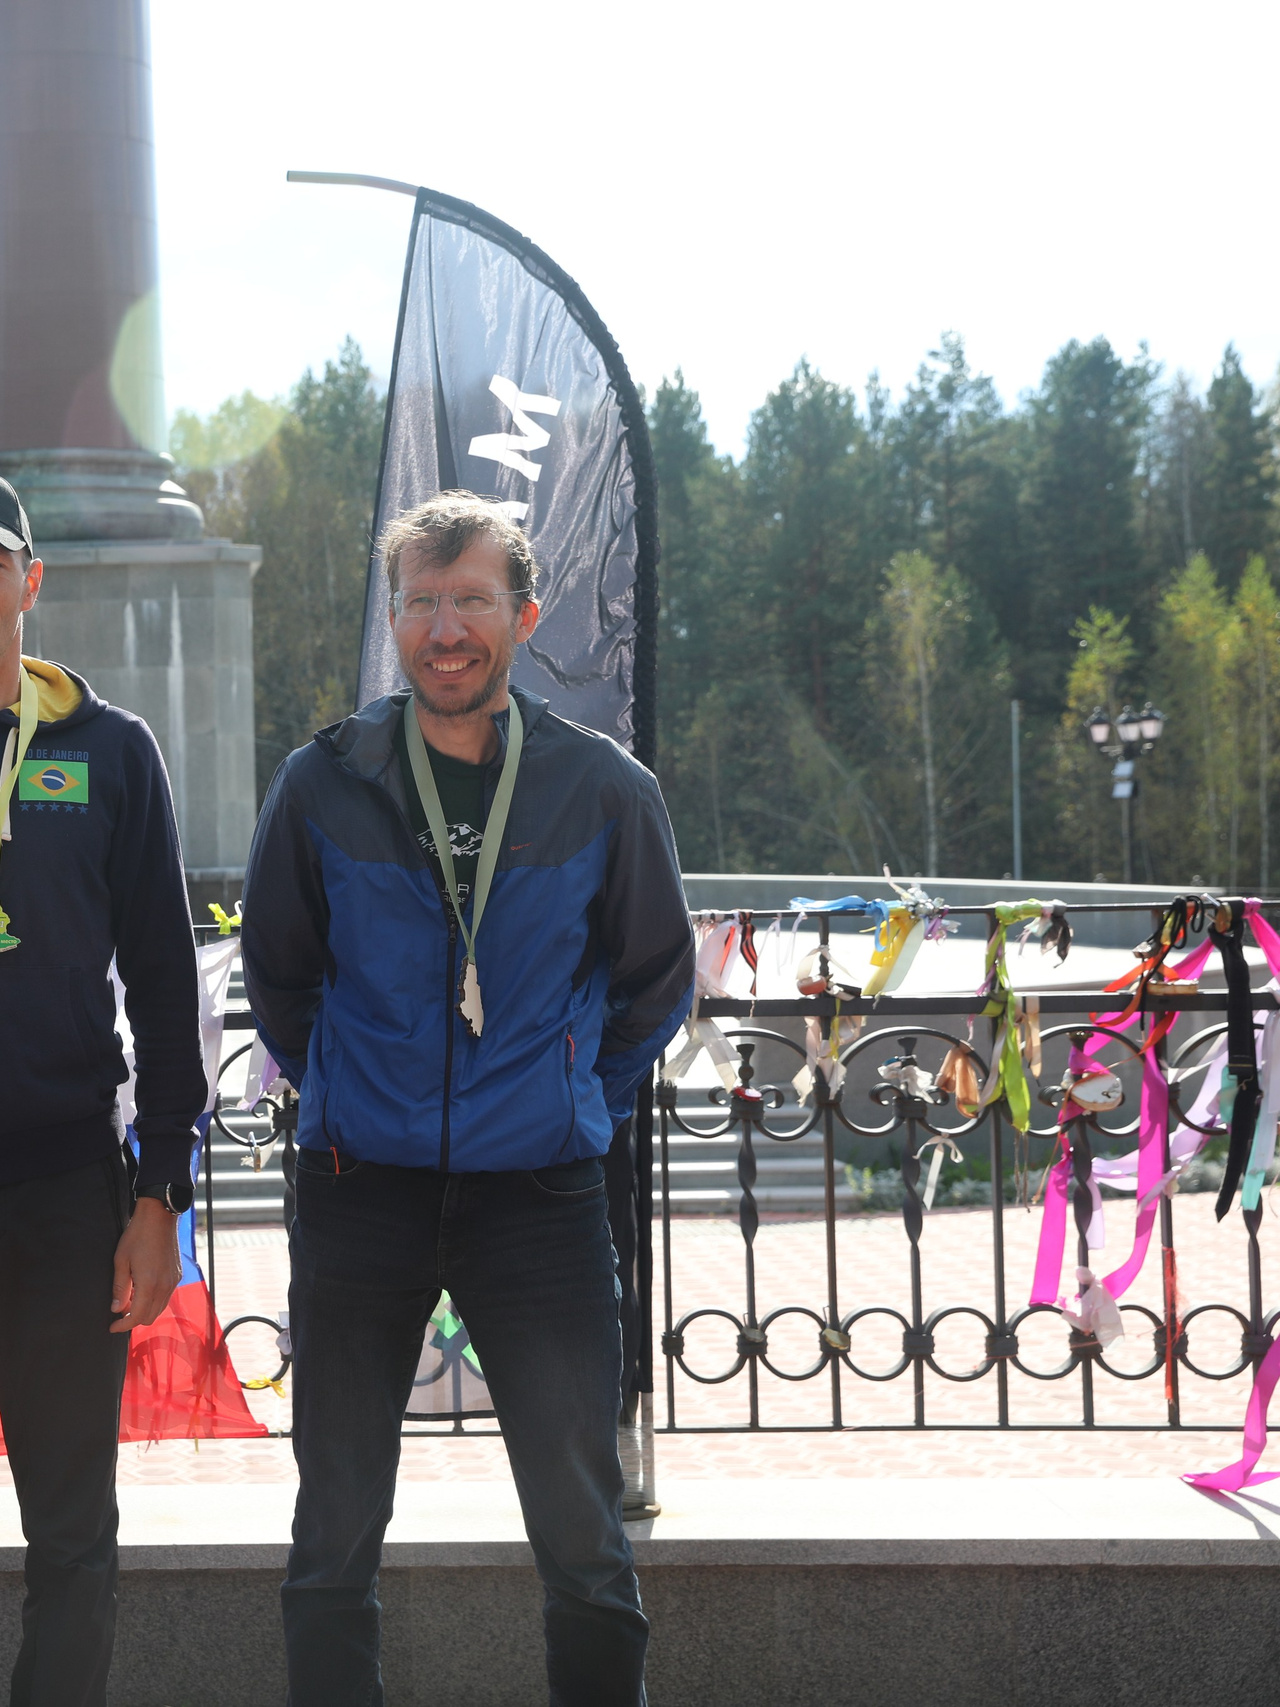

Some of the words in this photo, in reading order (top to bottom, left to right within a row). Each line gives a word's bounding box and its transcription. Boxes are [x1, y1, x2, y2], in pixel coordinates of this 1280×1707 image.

[468, 373, 562, 520] M
[36, 748, 48, 759] DE
[49, 749, 89, 762] JANEIRO
